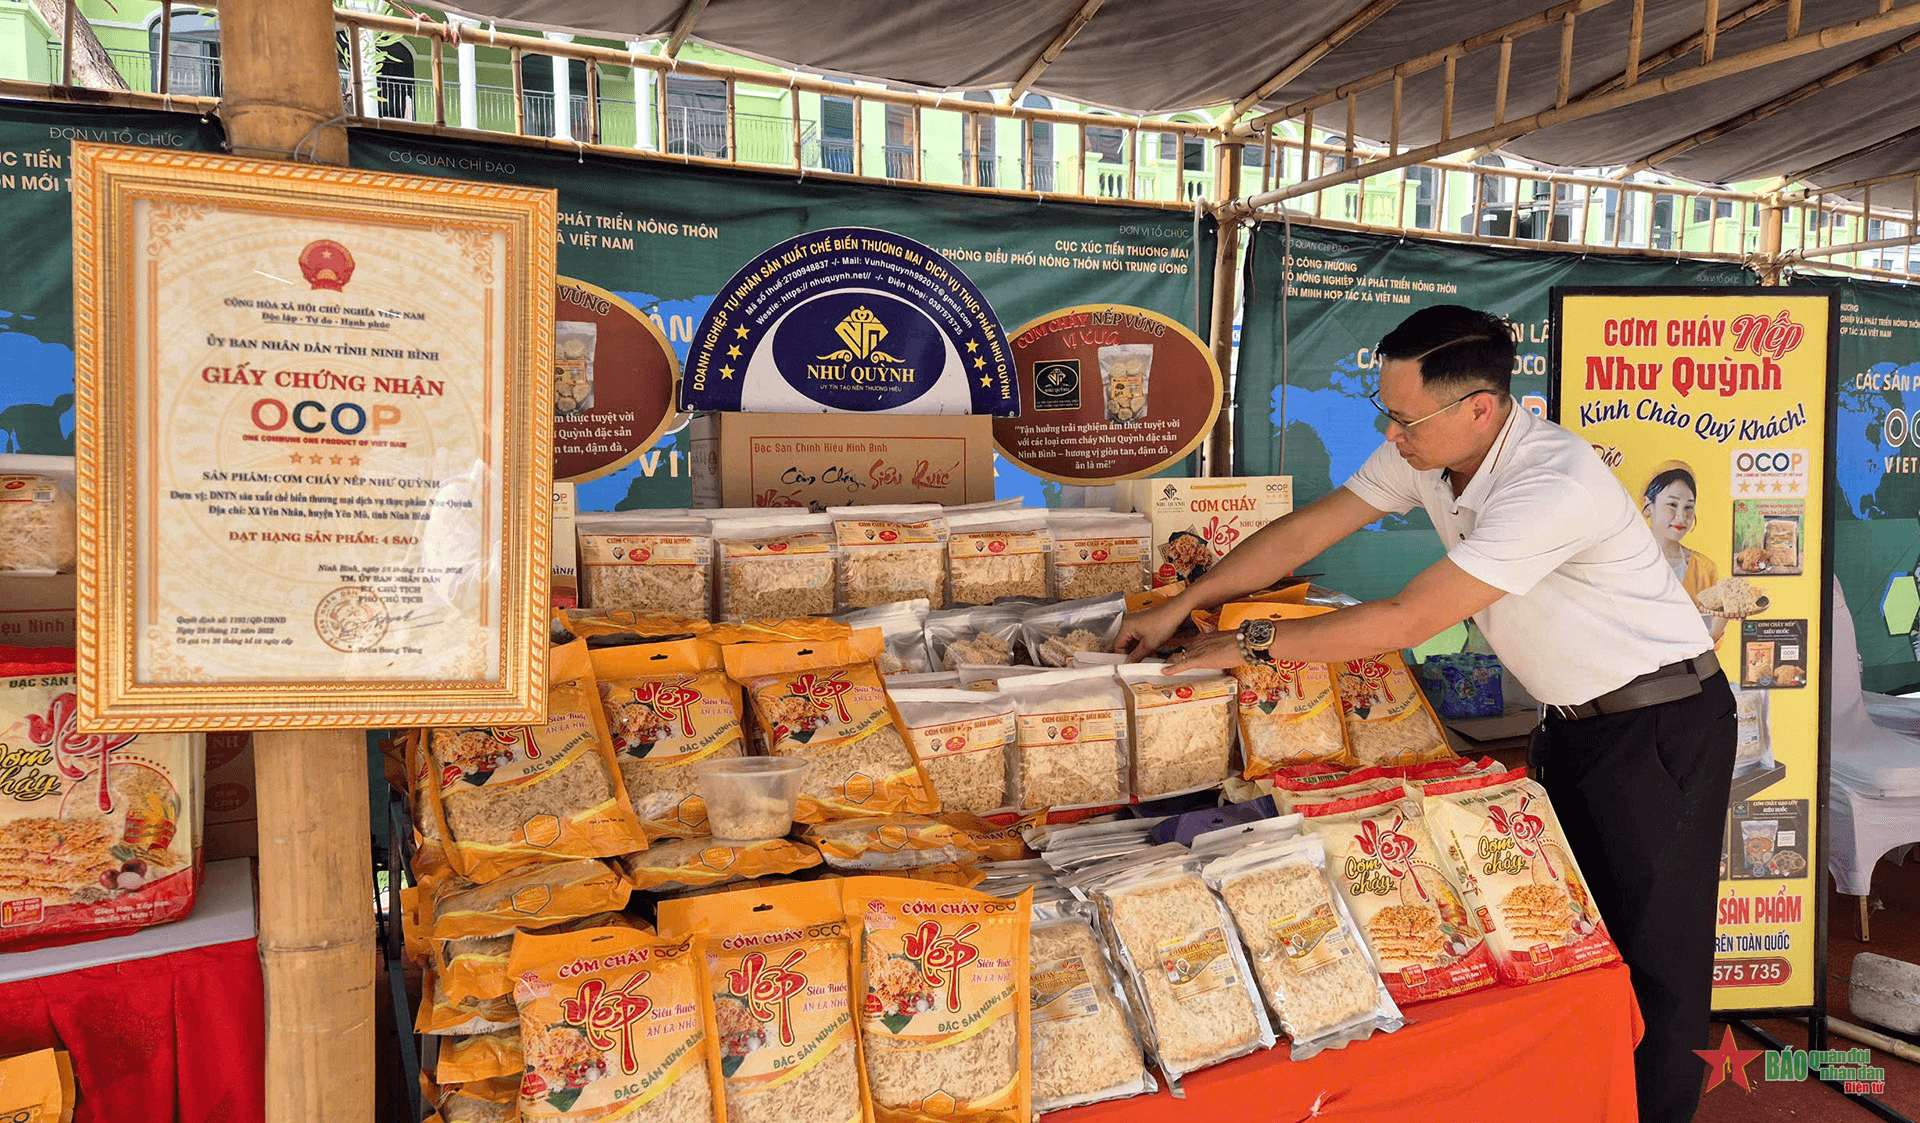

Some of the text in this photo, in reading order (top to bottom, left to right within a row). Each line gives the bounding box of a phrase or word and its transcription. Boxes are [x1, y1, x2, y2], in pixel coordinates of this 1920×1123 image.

[50, 127, 183, 146] ĐƠN TỔ CHỨC
[23, 149, 61, 169] TIẾN
[22, 173, 59, 192] MỚI
[557, 210, 718, 239] PHÁT TRIỂN NÔNG THÔN
[569, 231, 634, 250] VIỆT NAM
[809, 236, 832, 255] CHẾ
[834, 234, 858, 250] BIẾN
[861, 239, 903, 258] THƯƠNG
[1055, 240, 1189, 259] CỤC XÚC TIẾN THƯƠNG MẠI
[781, 244, 807, 267] XUẤT
[904, 249, 923, 266] MẠI
[943, 246, 1188, 275] PHÒNG ĐIỀU PHỐI NÔNG THÔN MỚI TRUNG ƯƠNG
[1296, 256, 1357, 272] CÔNG THƯƠNG
[760, 259, 782, 278] SẢN
[925, 260, 948, 282] DỊCH
[735, 273, 762, 300] NHÂN
[745, 304, 758, 316] Mã
[757, 293, 767, 305] số
[842, 257, 862, 265] Mail:
[948, 277, 961, 292] VỤ
[1296, 271, 1457, 294] NÔNG NGHIỆP VÀ PHÁT TRIỂN NÔNG THÔN
[557, 285, 610, 316] VỪNG
[756, 302, 783, 326] Westie:
[888, 276, 906, 289] Điện
[907, 284, 929, 301] thoại:
[928, 298, 963, 336] 0387575735
[958, 288, 980, 314] THỰC
[1300, 287, 1410, 305] MINH HỢP TÁC XÃ VIỆT NAM
[703, 310, 728, 351] NGHIỆP
[976, 312, 997, 340] PHẨM
[1017, 307, 1166, 349] CƠM CHÁY NẾP VỪNG
[1604, 310, 1804, 360] CƠM CHÁY Nếp
[206, 333, 440, 361] ỦY BAN NHÂN DÂN TỈNH NINH BÌNH
[989, 341, 1006, 363] NHƯ
[202, 361, 445, 398] GIẤY CHỨNG NHẬN
[693, 351, 711, 391] DOANH
[807, 363, 915, 383] NHƯ QUỲNH
[997, 363, 1010, 400] QUỲNH
[1584, 355, 1783, 398] Như Quỳnh
[1856, 368, 1910, 392] CÁC SẢN
[250, 398, 402, 435] OCOP
[566, 412, 634, 425] thực tuyệt vời
[1580, 397, 1807, 443] Kính Chào Quý Khách!
[559, 426, 632, 441] Quỳnh đặc sản
[1018, 432, 1177, 448] với các loại cơm cháy Như Quỳnh đặc sản
[563, 441, 622, 455] tan, đậm đà
[1736, 452, 1802, 472] OCOP
[1266, 483, 1288, 491] OCOP
[1190, 499, 1220, 512] CƠM
[1221, 495, 1257, 511] CHÁY
[9, 678, 37, 689] ĐẶC
[630, 677, 702, 738] Nếp
[786, 670, 854, 725] Nếp
[1477, 835, 1514, 859] Cơm
[1488, 795, 1559, 882] Nếp
[1345, 856, 1382, 880] Cơm
[1482, 851, 1530, 876] cháy
[1350, 871, 1398, 896] cháy
[1718, 885, 1802, 925] SẢN PHẨM
[1715, 930, 1790, 952] RÊN TOÀN QUỐC
[901, 919, 981, 1014] Nếp
[1713, 963, 1781, 980] 575 735
[725, 949, 808, 1047] Nếp
[560, 970, 652, 1075] Nếp
[938, 995, 1001, 1033] ĐẶC SẢN NINH
[614, 1047, 687, 1100] ĐẶC SẢN NINH
